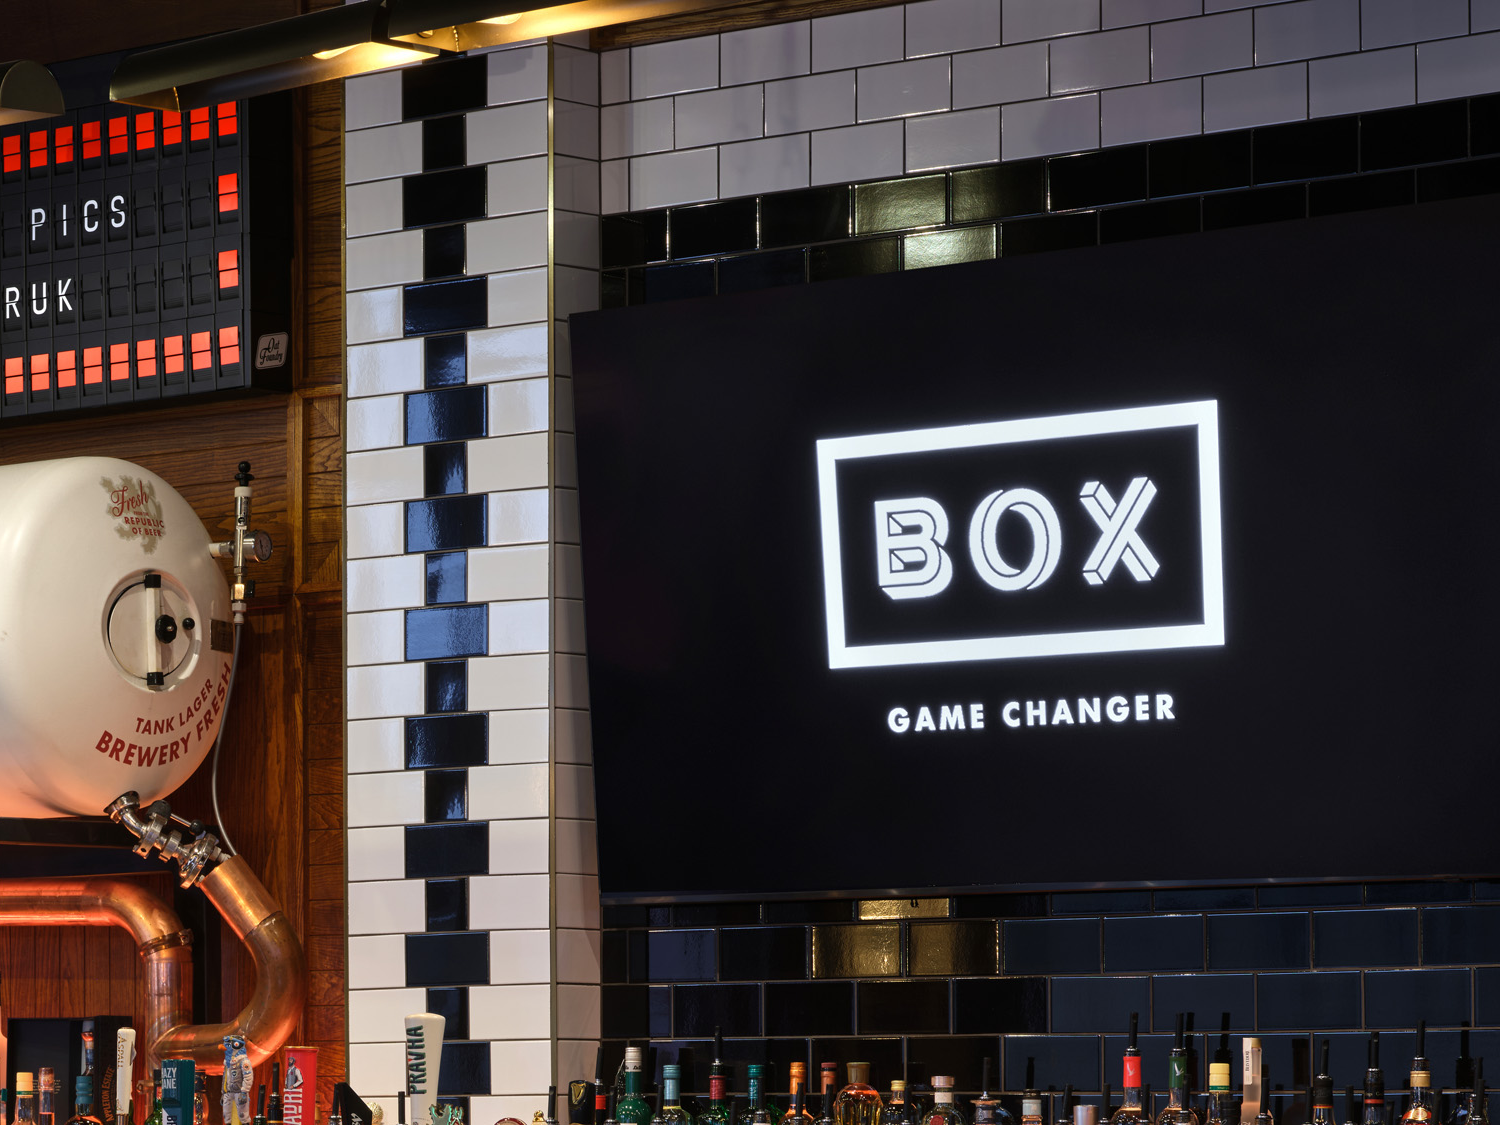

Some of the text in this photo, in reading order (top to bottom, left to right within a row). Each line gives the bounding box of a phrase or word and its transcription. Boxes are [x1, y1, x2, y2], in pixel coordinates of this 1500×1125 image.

[30, 194, 128, 242] PICS
[111, 479, 149, 517] Fresh
[124, 516, 165, 528] REPUBLIC
[132, 527, 162, 537] OF BEER
[874, 476, 1161, 600] BOX
[95, 661, 232, 768] BREWERY FRESH
[135, 677, 214, 736] TANK LAGER
[887, 692, 1176, 734] GAME CHANGER
[406, 1024, 427, 1095] PRAVHA
[102, 1064, 116, 1122] APPLETON ESTATE
